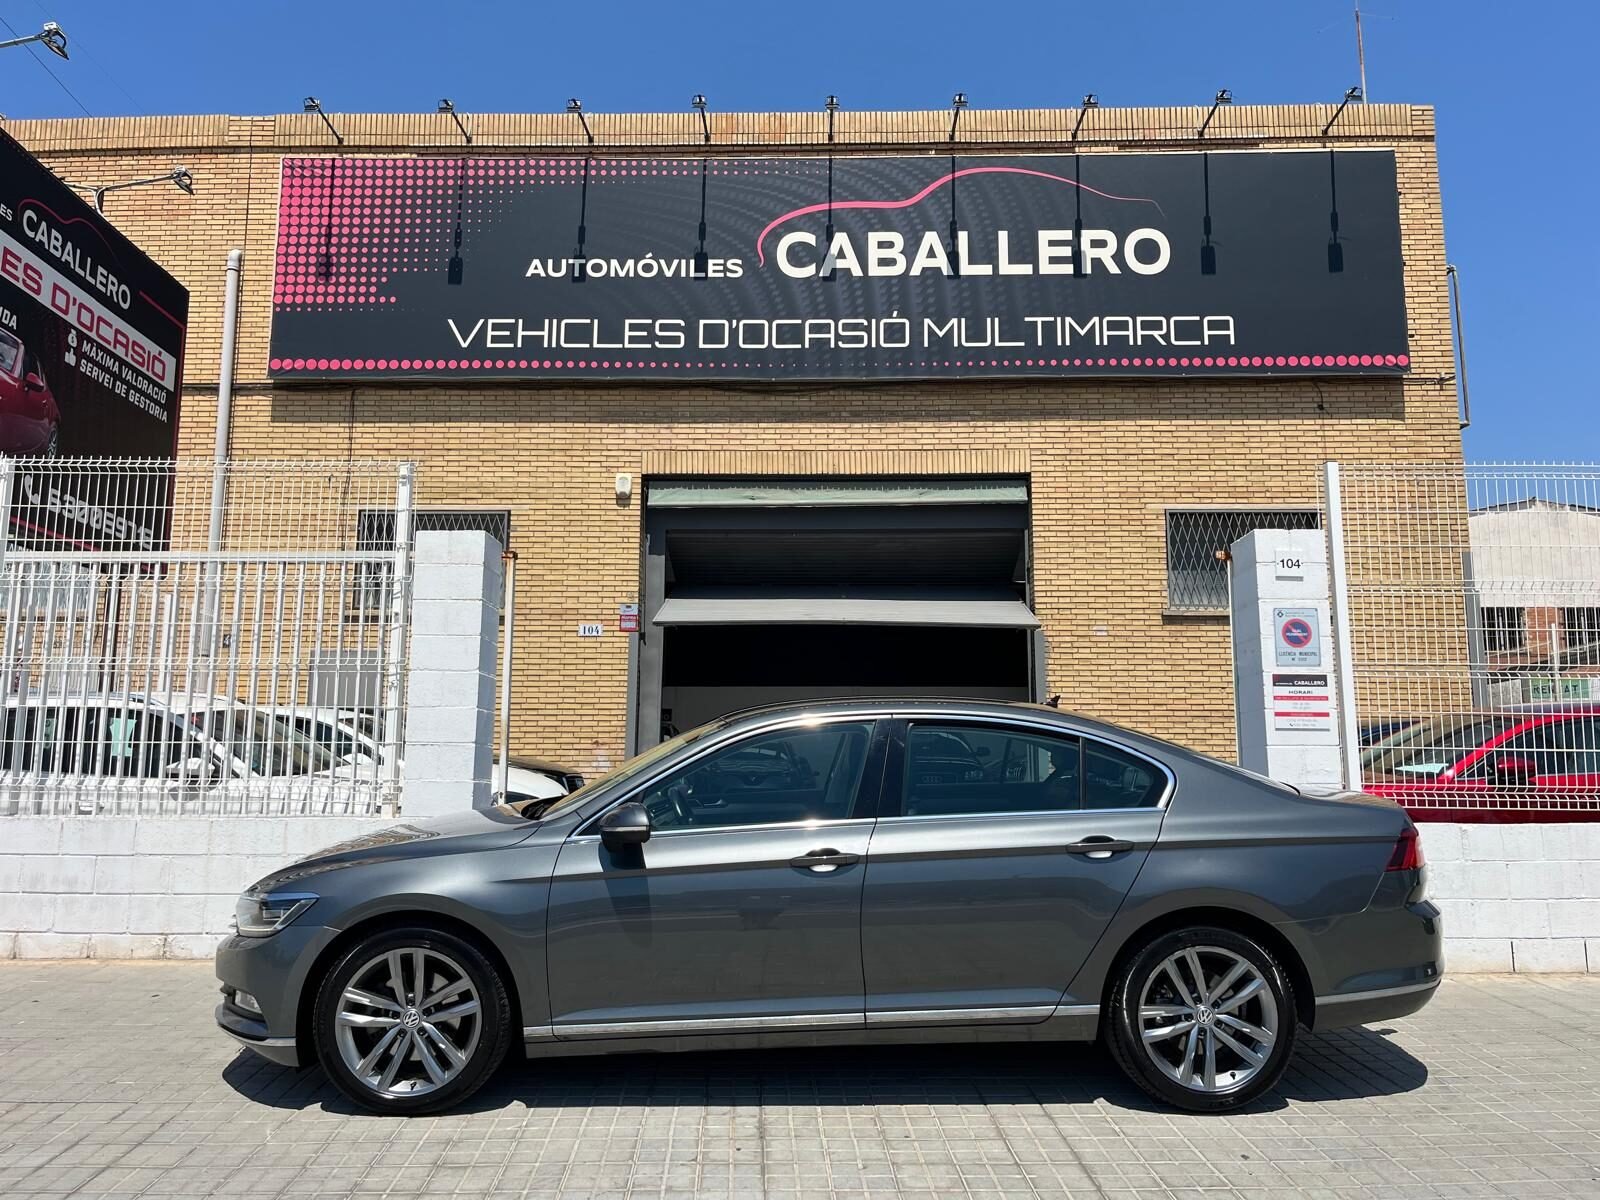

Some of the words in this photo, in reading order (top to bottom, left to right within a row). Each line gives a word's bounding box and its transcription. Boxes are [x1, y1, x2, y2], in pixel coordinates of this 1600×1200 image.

[23, 209, 131, 310] CABALLERO
[525, 252, 743, 278] AUTOMÓVILES
[776, 227, 1172, 279] CABALLERO
[51, 281, 166, 382] D'OCASIÓ
[447, 318, 686, 349] VEHICLES
[698, 311, 910, 349] D'OCASIÓ
[923, 315, 1236, 348] MULTIMARCA
[79, 358, 114, 390] SERVEI
[114, 380, 128, 398] DE
[128, 389, 168, 423] GESTORIA
[81, 339, 119, 374] MÀXIMA
[121, 364, 167, 405] VALORACIÓ
[1279, 558, 1301, 569] 104
[583, 625, 600, 635] 104
